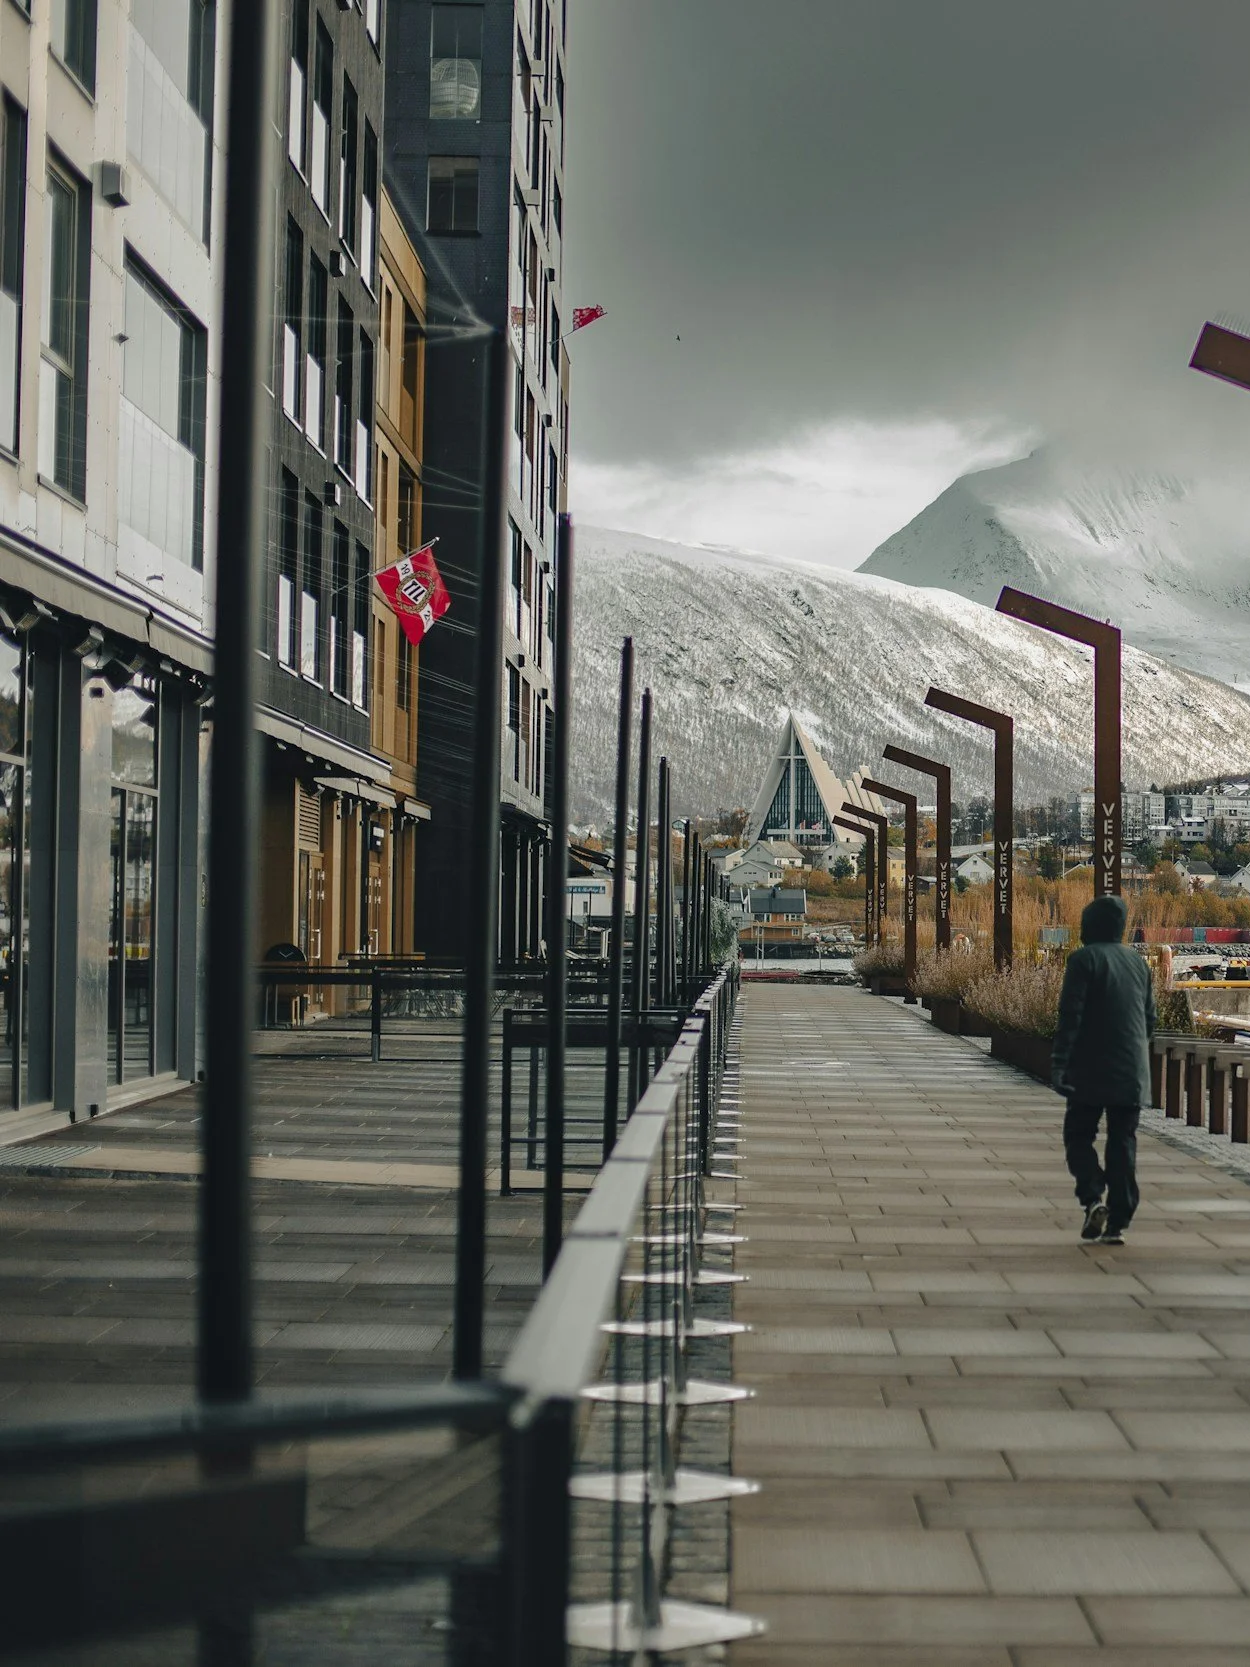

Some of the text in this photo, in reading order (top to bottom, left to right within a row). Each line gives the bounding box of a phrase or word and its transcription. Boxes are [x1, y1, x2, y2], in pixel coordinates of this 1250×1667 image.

[400, 563, 410, 575] 19
[403, 580, 425, 602] TIL
[999, 841, 1009, 914] VERVET
